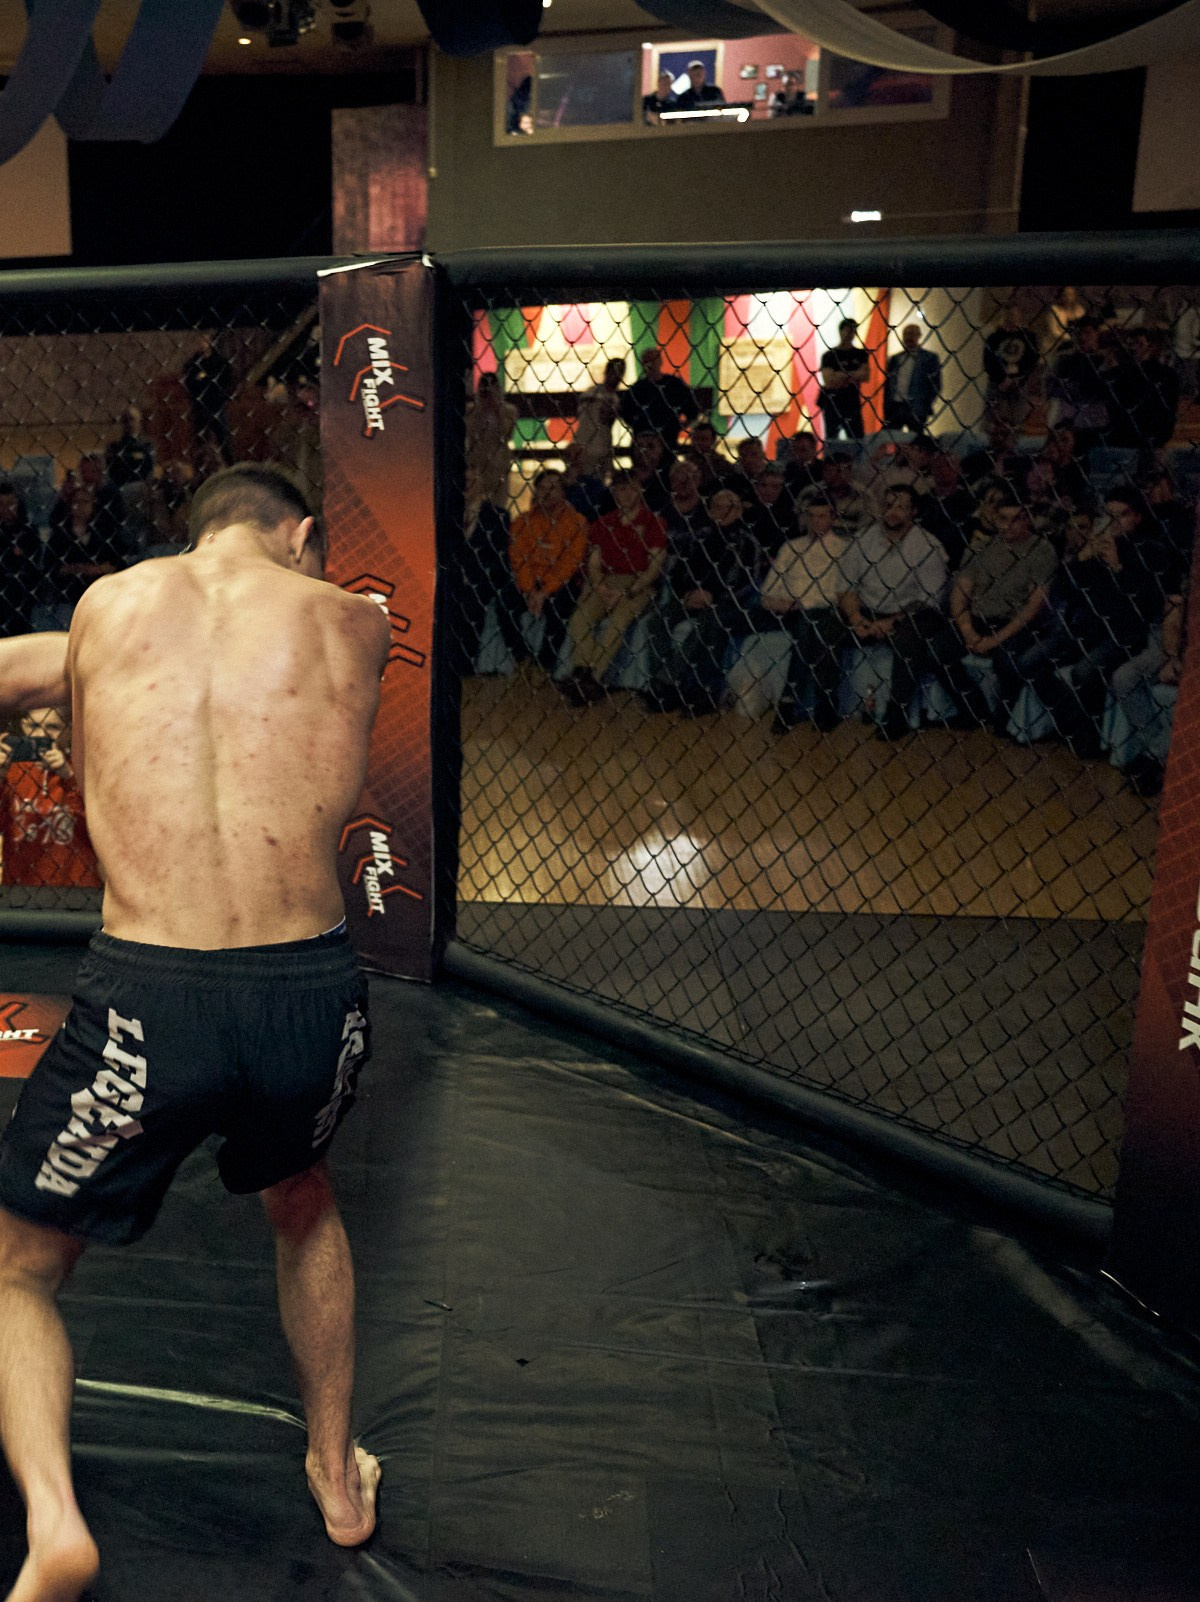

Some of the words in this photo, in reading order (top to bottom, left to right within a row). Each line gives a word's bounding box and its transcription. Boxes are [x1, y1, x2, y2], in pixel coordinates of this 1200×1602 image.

[367, 337, 395, 386] MIX
[362, 378, 385, 431] FIGHT
[369, 830, 395, 876] MIX
[363, 866, 385, 915] FIGHT
[34, 1007, 147, 1198] LEGENDA
